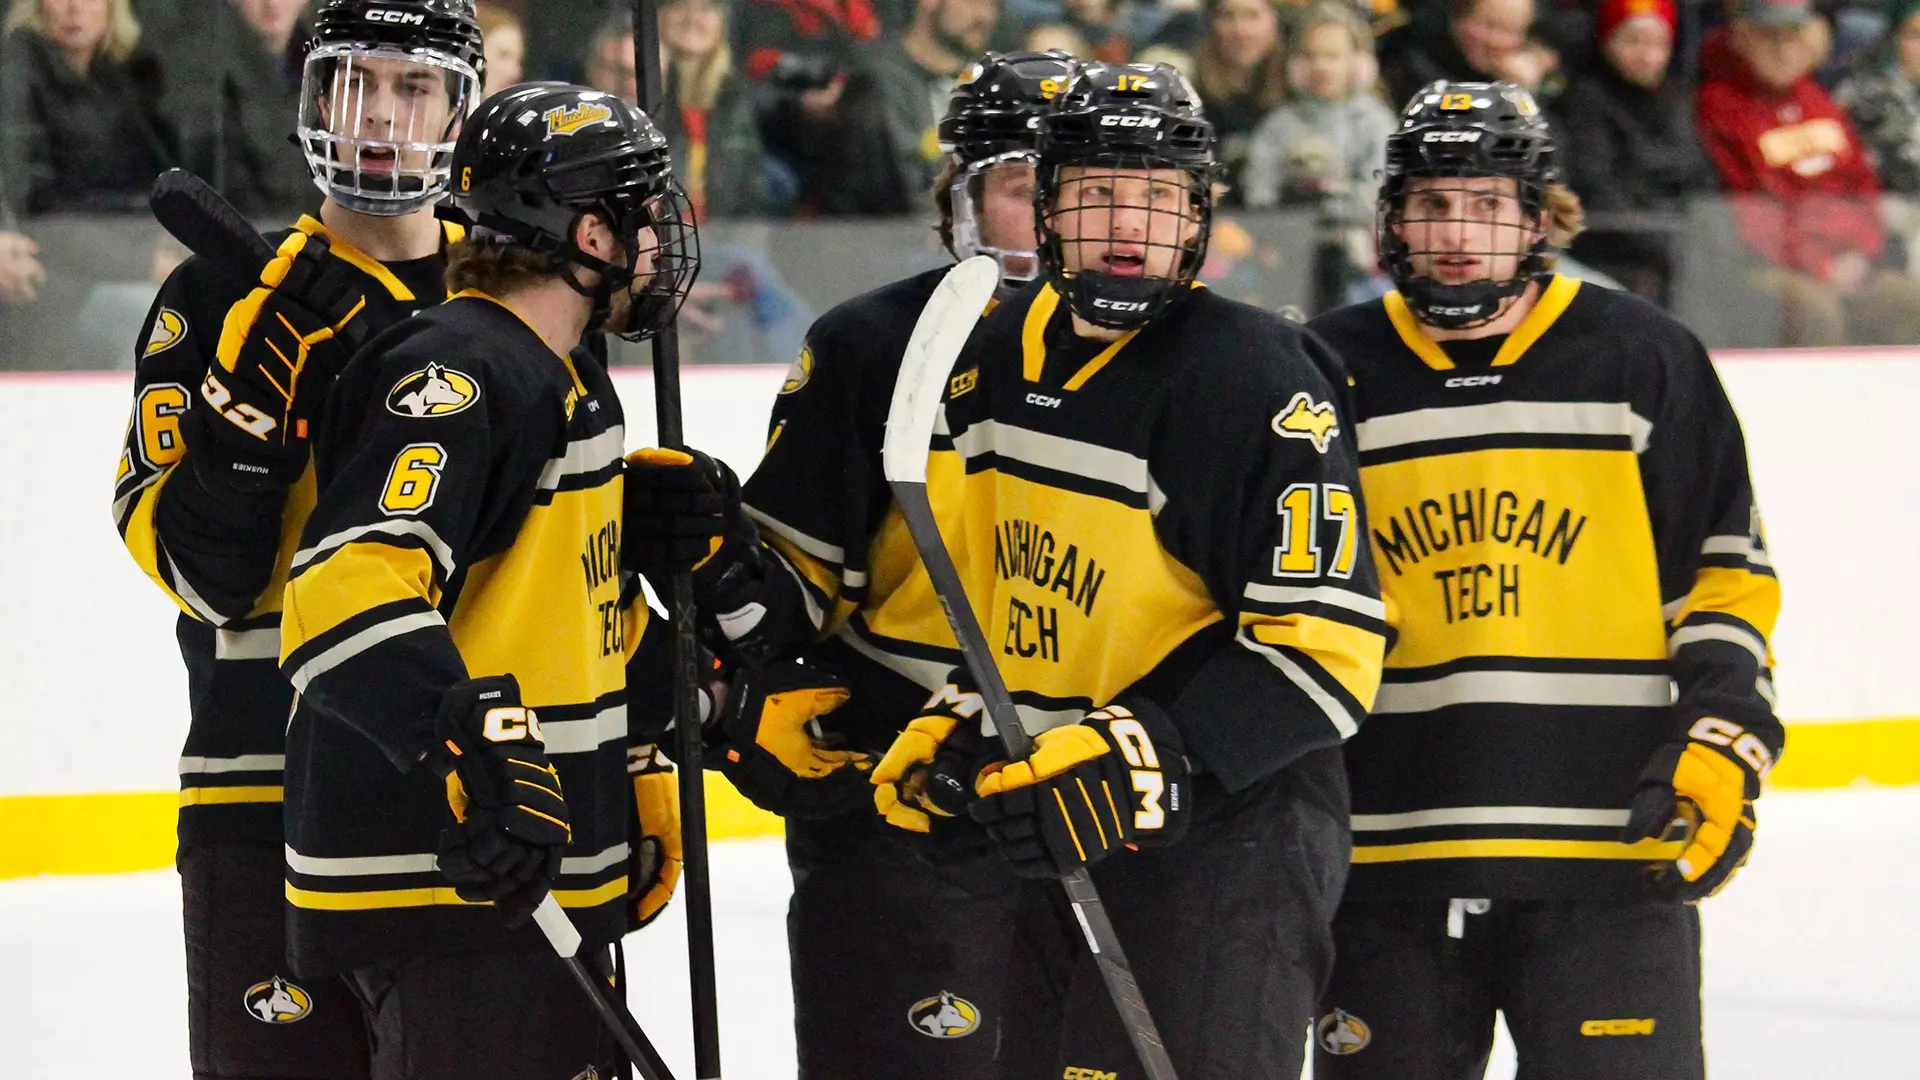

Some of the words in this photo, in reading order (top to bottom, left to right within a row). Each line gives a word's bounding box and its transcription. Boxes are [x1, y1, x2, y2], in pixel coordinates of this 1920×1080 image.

[365, 9, 425, 26] CCM
[1117, 75, 1148, 91] 17
[1100, 115, 1161, 128] CCM
[1423, 131, 1482, 143] CCM
[461, 167, 472, 192] 6
[1093, 298, 1149, 312] CCM
[1444, 374, 1503, 388] CCM
[1025, 392, 1062, 408] CCM
[378, 442, 448, 516] 6
[1272, 483, 1357, 579] 17
[1373, 488, 1587, 576] MICHIGAN
[1434, 563, 1521, 625] TECH
[1580, 1018, 1656, 1036] CCM
